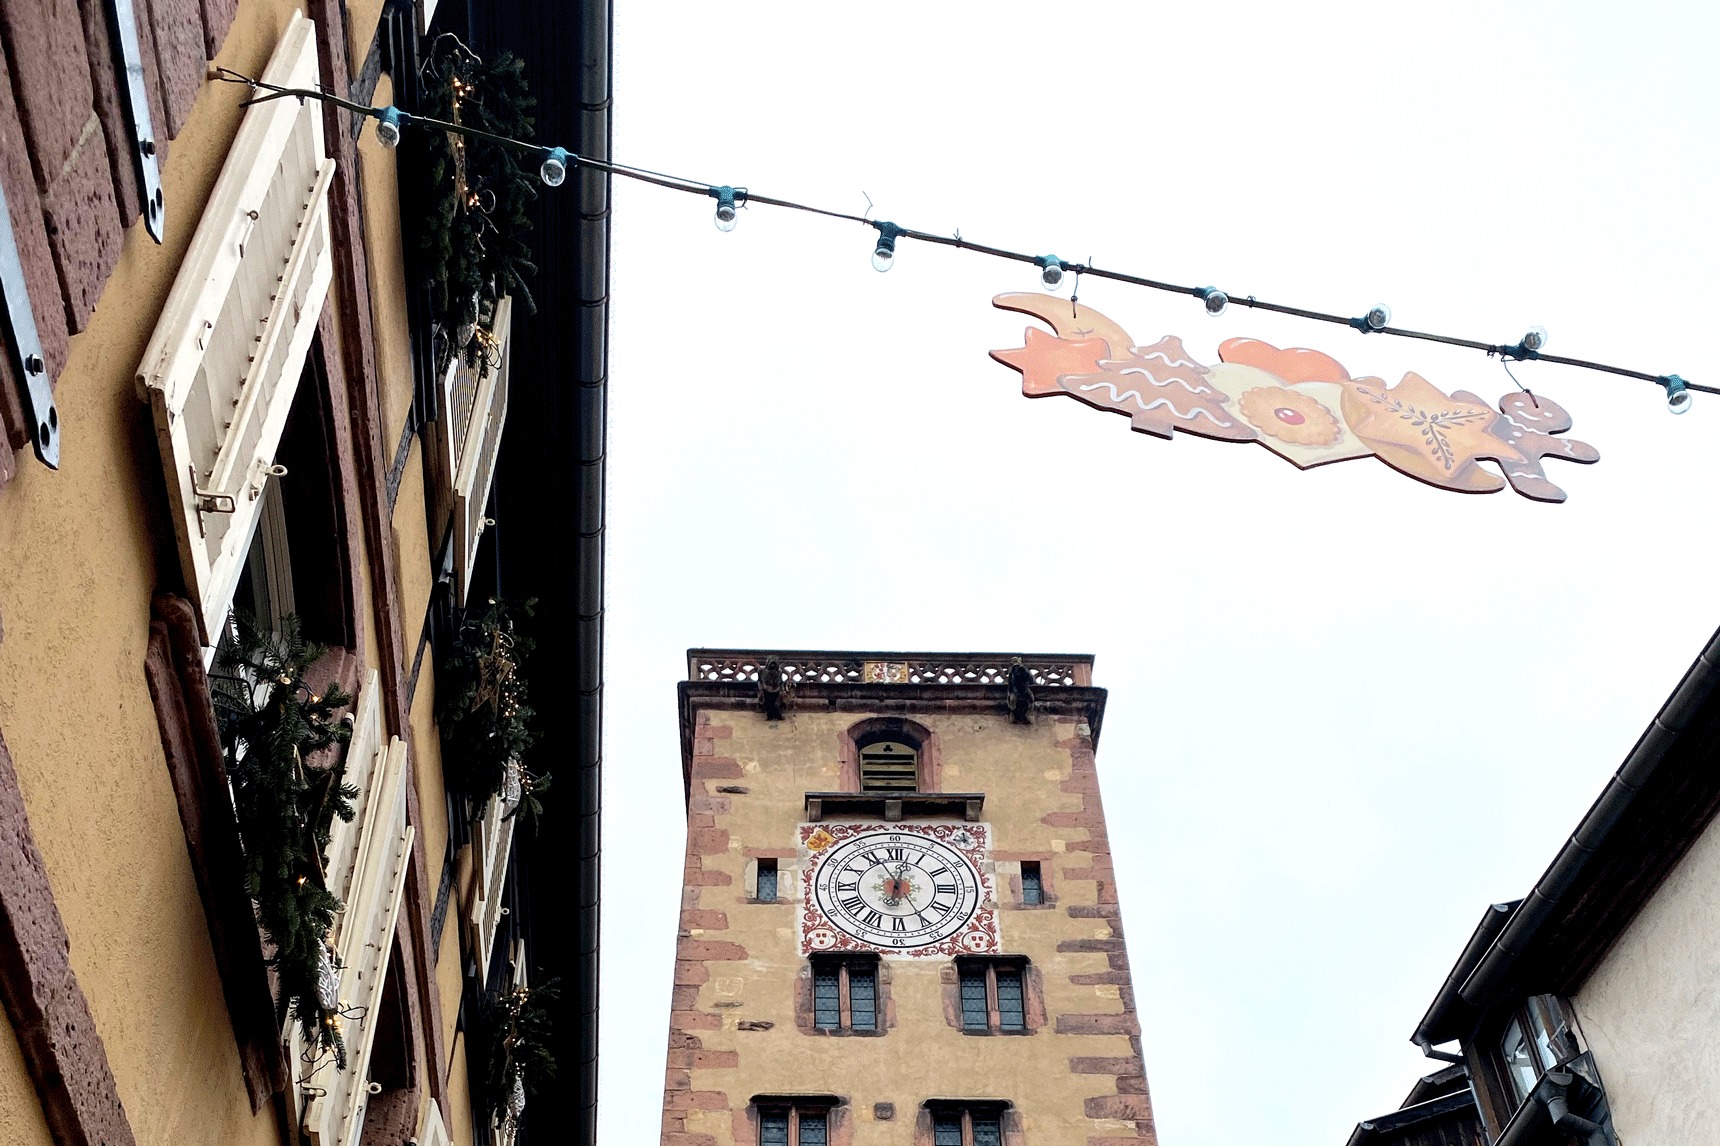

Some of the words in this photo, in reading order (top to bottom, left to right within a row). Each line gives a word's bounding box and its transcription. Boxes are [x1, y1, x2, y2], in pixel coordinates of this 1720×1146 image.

[853, 841, 866, 849] 55
[862, 852, 878, 866] XI
[886, 848, 904, 860] XII
[828, 858, 838, 868] 50
[954, 858, 963, 868] 10
[931, 867, 948, 877] II
[820, 883, 827, 891] 45
[838, 882, 856, 891] IX
[937, 884, 956, 895] III
[966, 885, 974, 893] 15
[827, 908, 838, 917] 40
[931, 901, 952, 917] IV
[863, 911, 883, 928] VII
[957, 911, 968, 921] 20
[892, 917, 906, 931] VI
